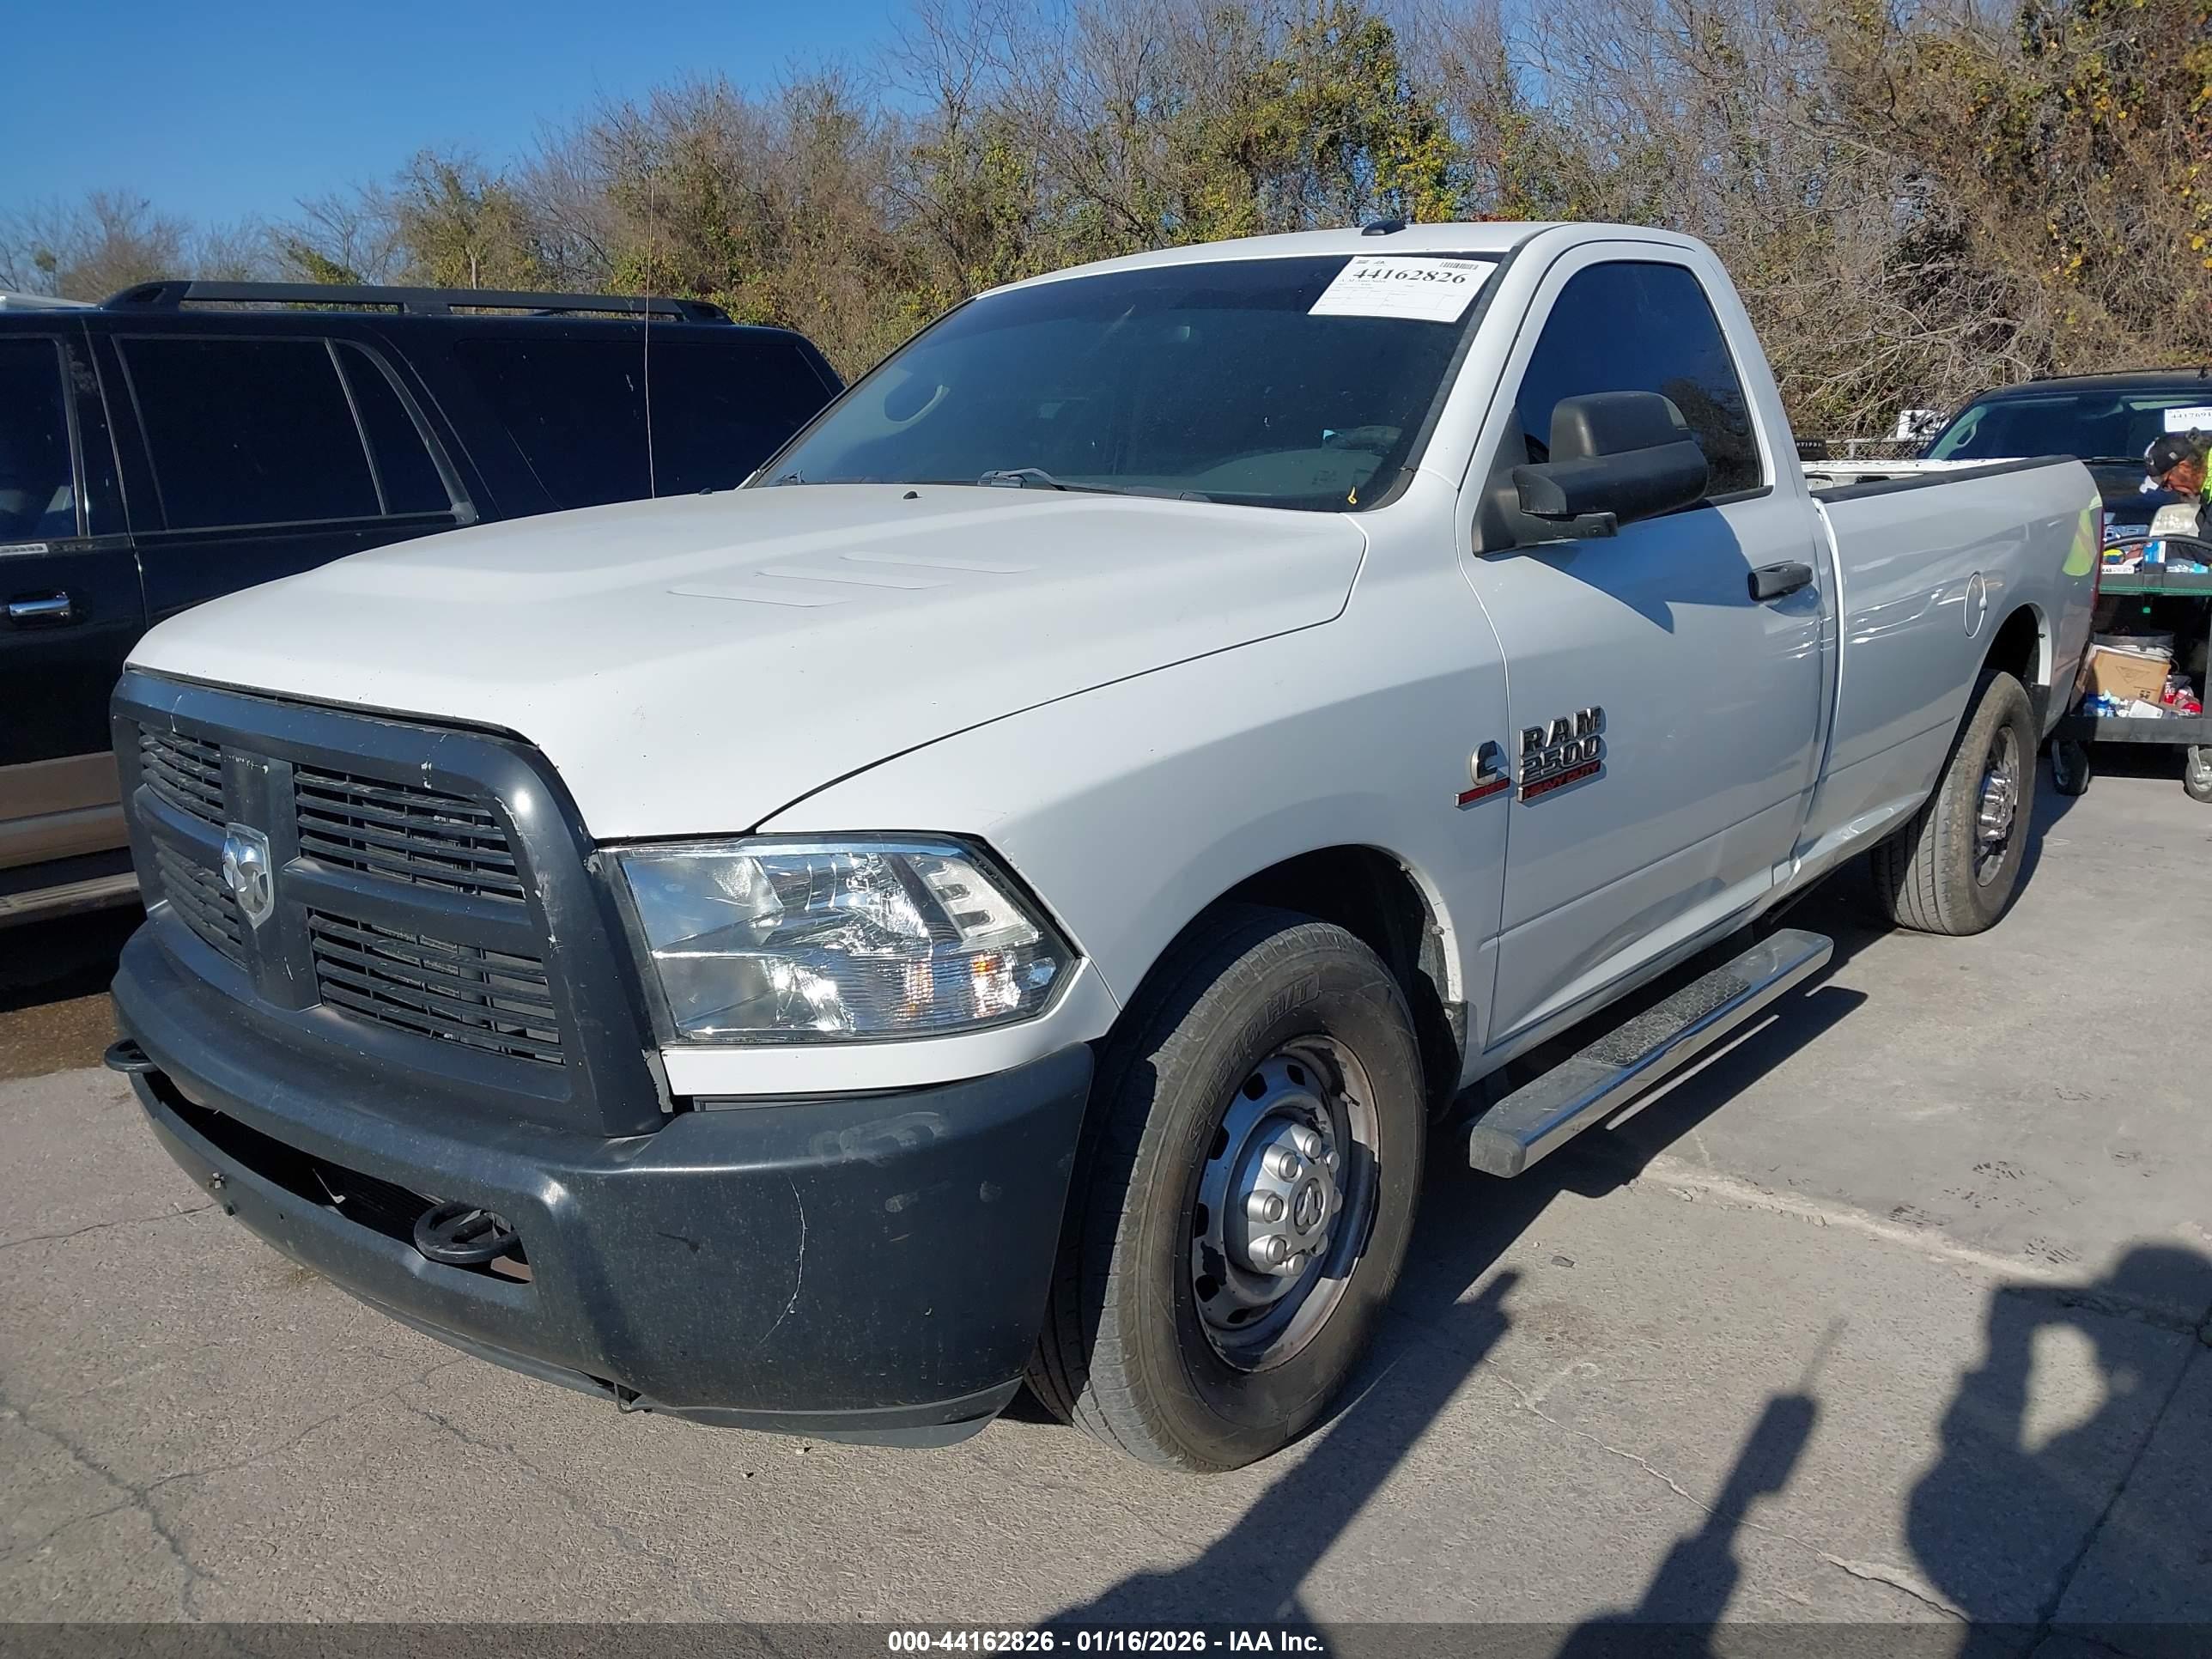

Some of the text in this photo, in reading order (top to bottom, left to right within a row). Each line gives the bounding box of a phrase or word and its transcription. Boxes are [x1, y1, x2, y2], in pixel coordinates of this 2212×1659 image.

[1352, 268, 1467, 285] 44162826
[1519, 706, 1601, 757] RAM
[1519, 735, 1601, 785] 2500
